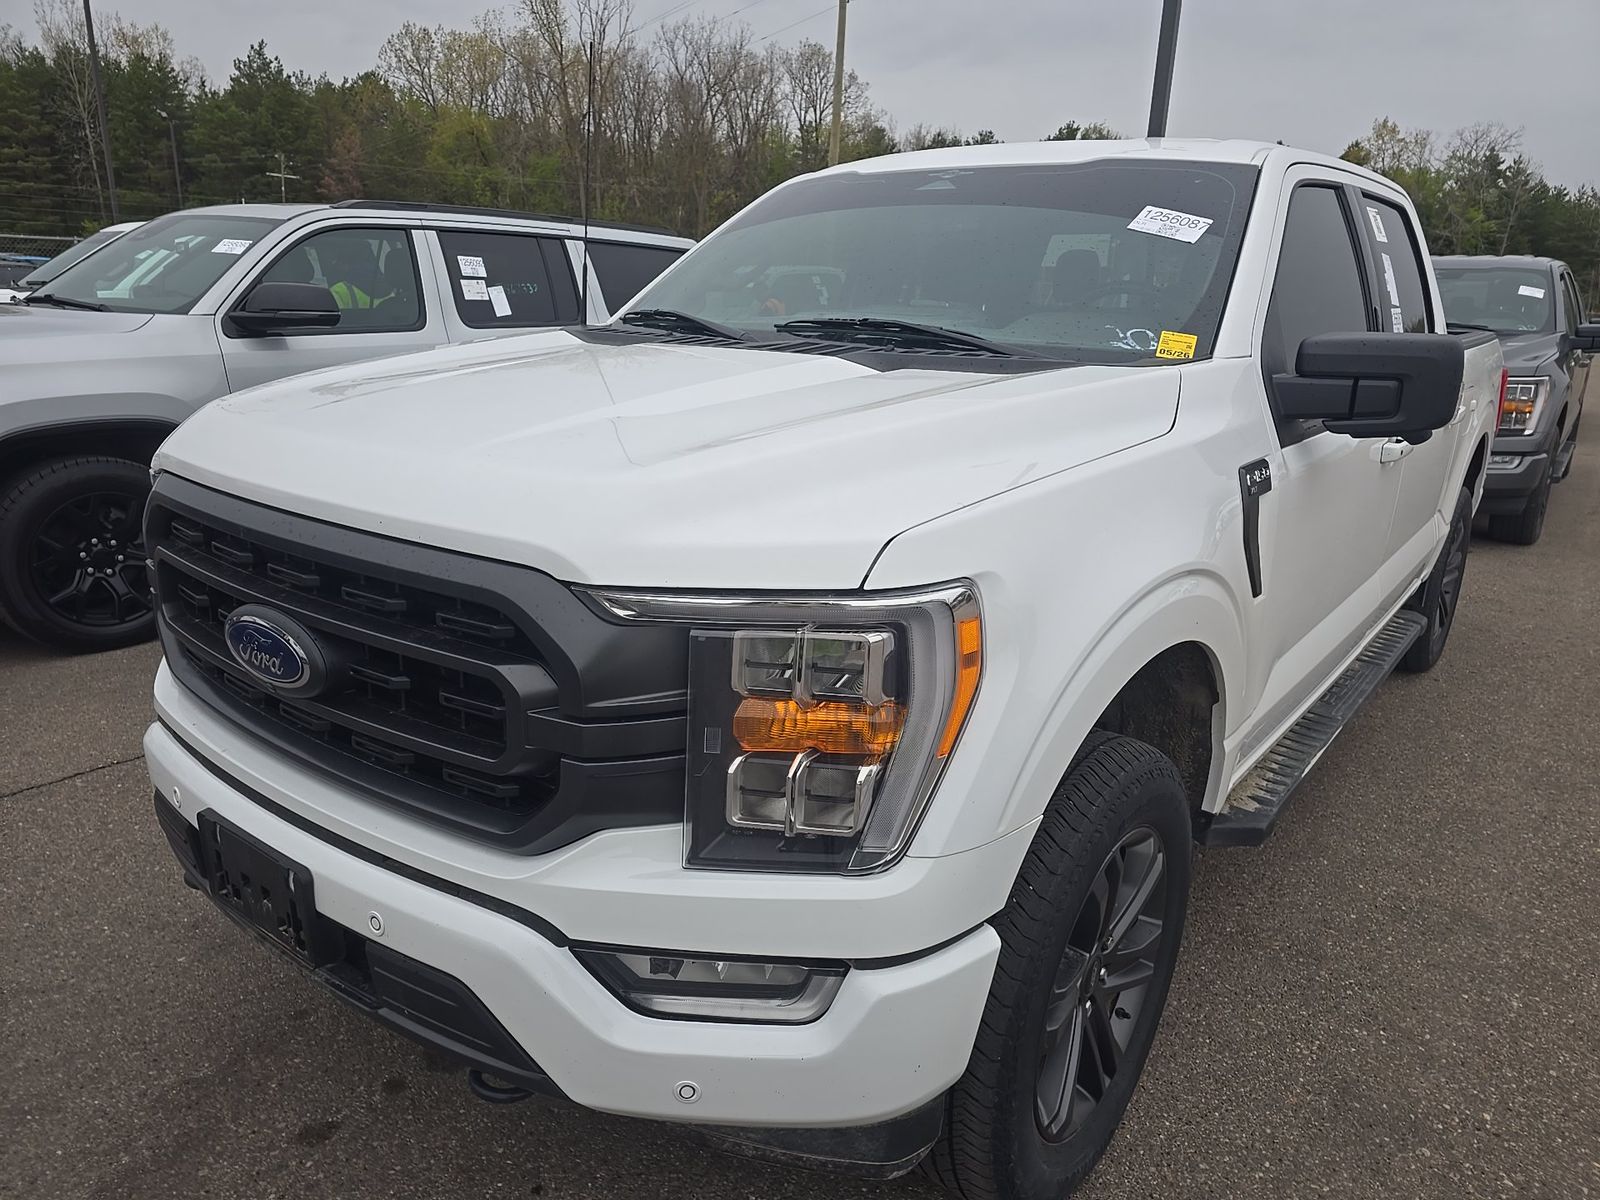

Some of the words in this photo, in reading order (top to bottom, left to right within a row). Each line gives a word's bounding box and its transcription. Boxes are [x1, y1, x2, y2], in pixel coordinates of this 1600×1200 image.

[1143, 209, 1211, 231] 1256087
[1159, 348, 1190, 359] 05/26
[239, 629, 285, 675] Ford
